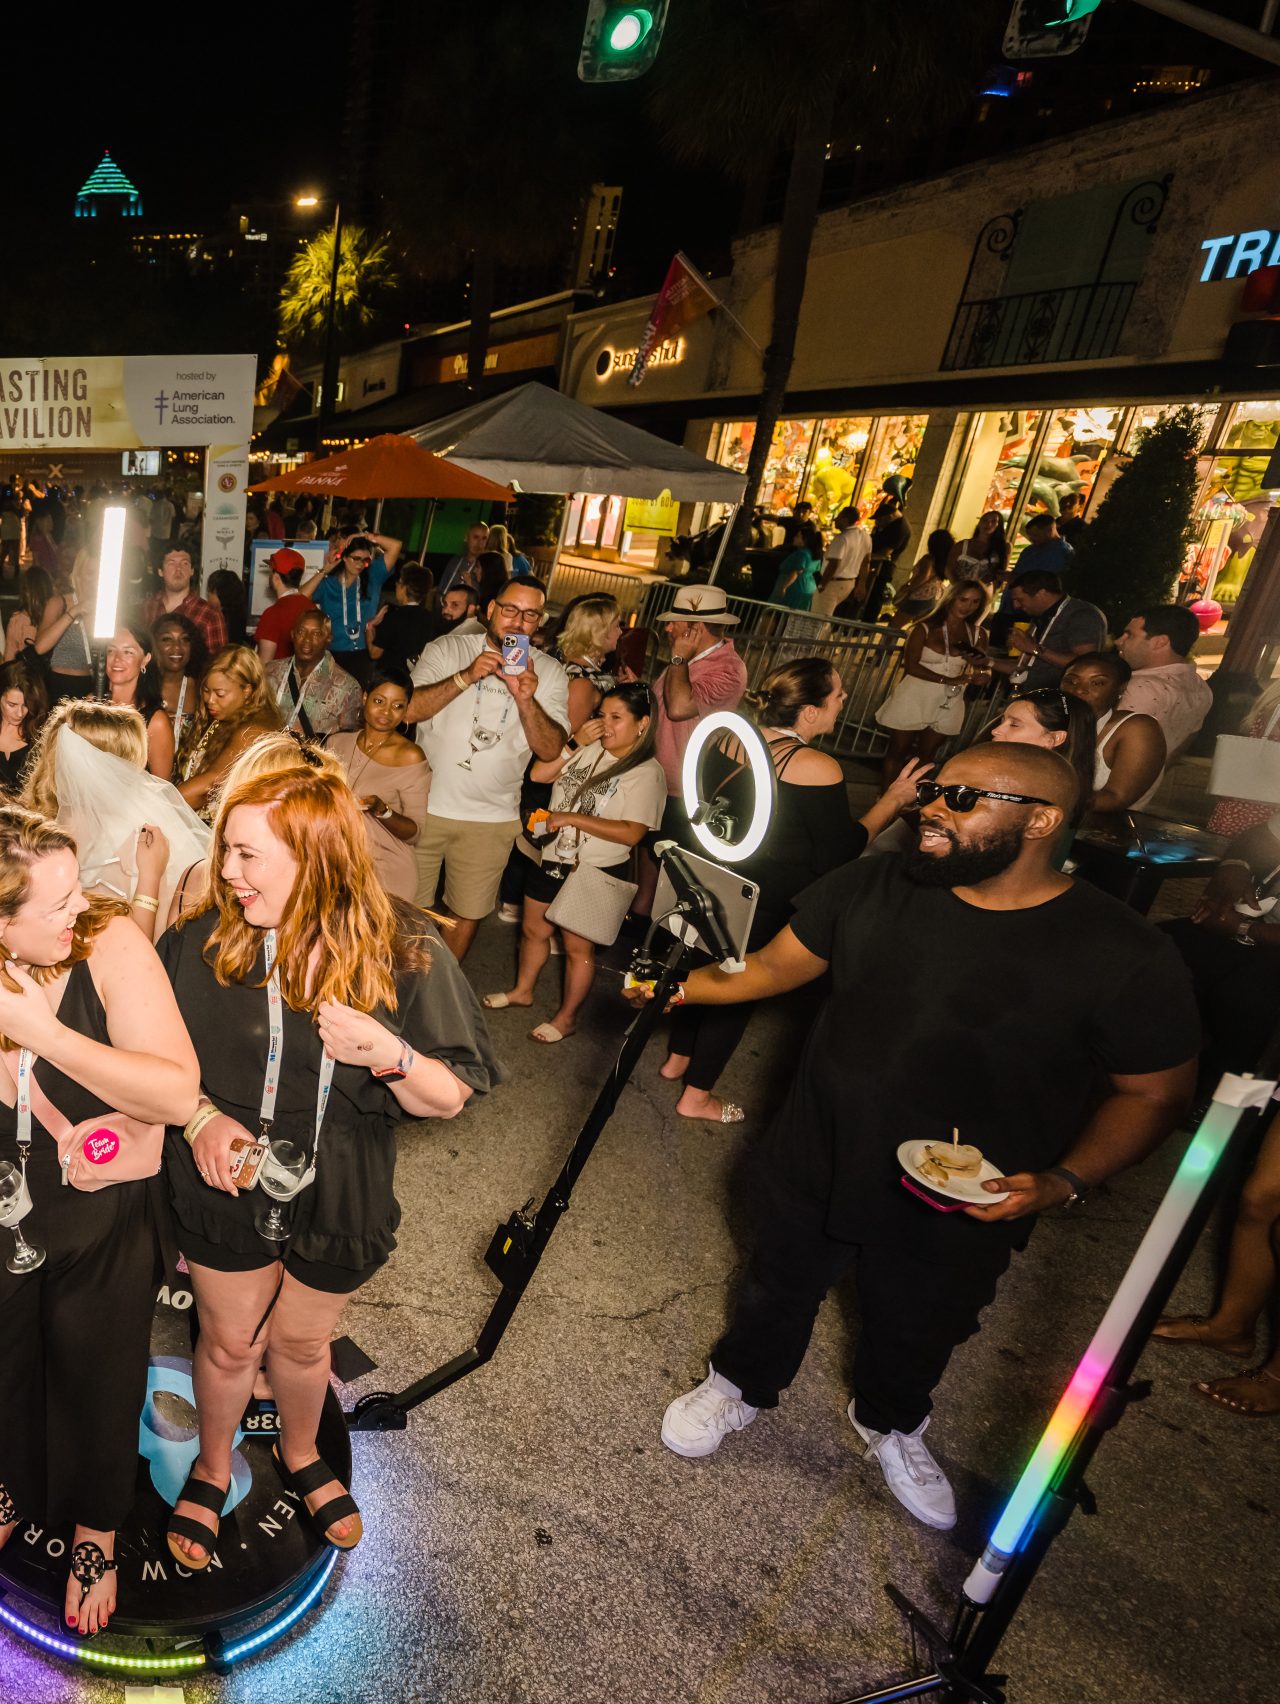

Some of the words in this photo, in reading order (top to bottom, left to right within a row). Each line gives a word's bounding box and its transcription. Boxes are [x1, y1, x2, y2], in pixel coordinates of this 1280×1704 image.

[175, 371, 206, 382] hosted
[207, 371, 217, 383] by
[172, 389, 225, 402] American
[172, 402, 199, 415] Lung
[87, 1137, 110, 1151] Team
[91, 1143, 115, 1161] Bride
